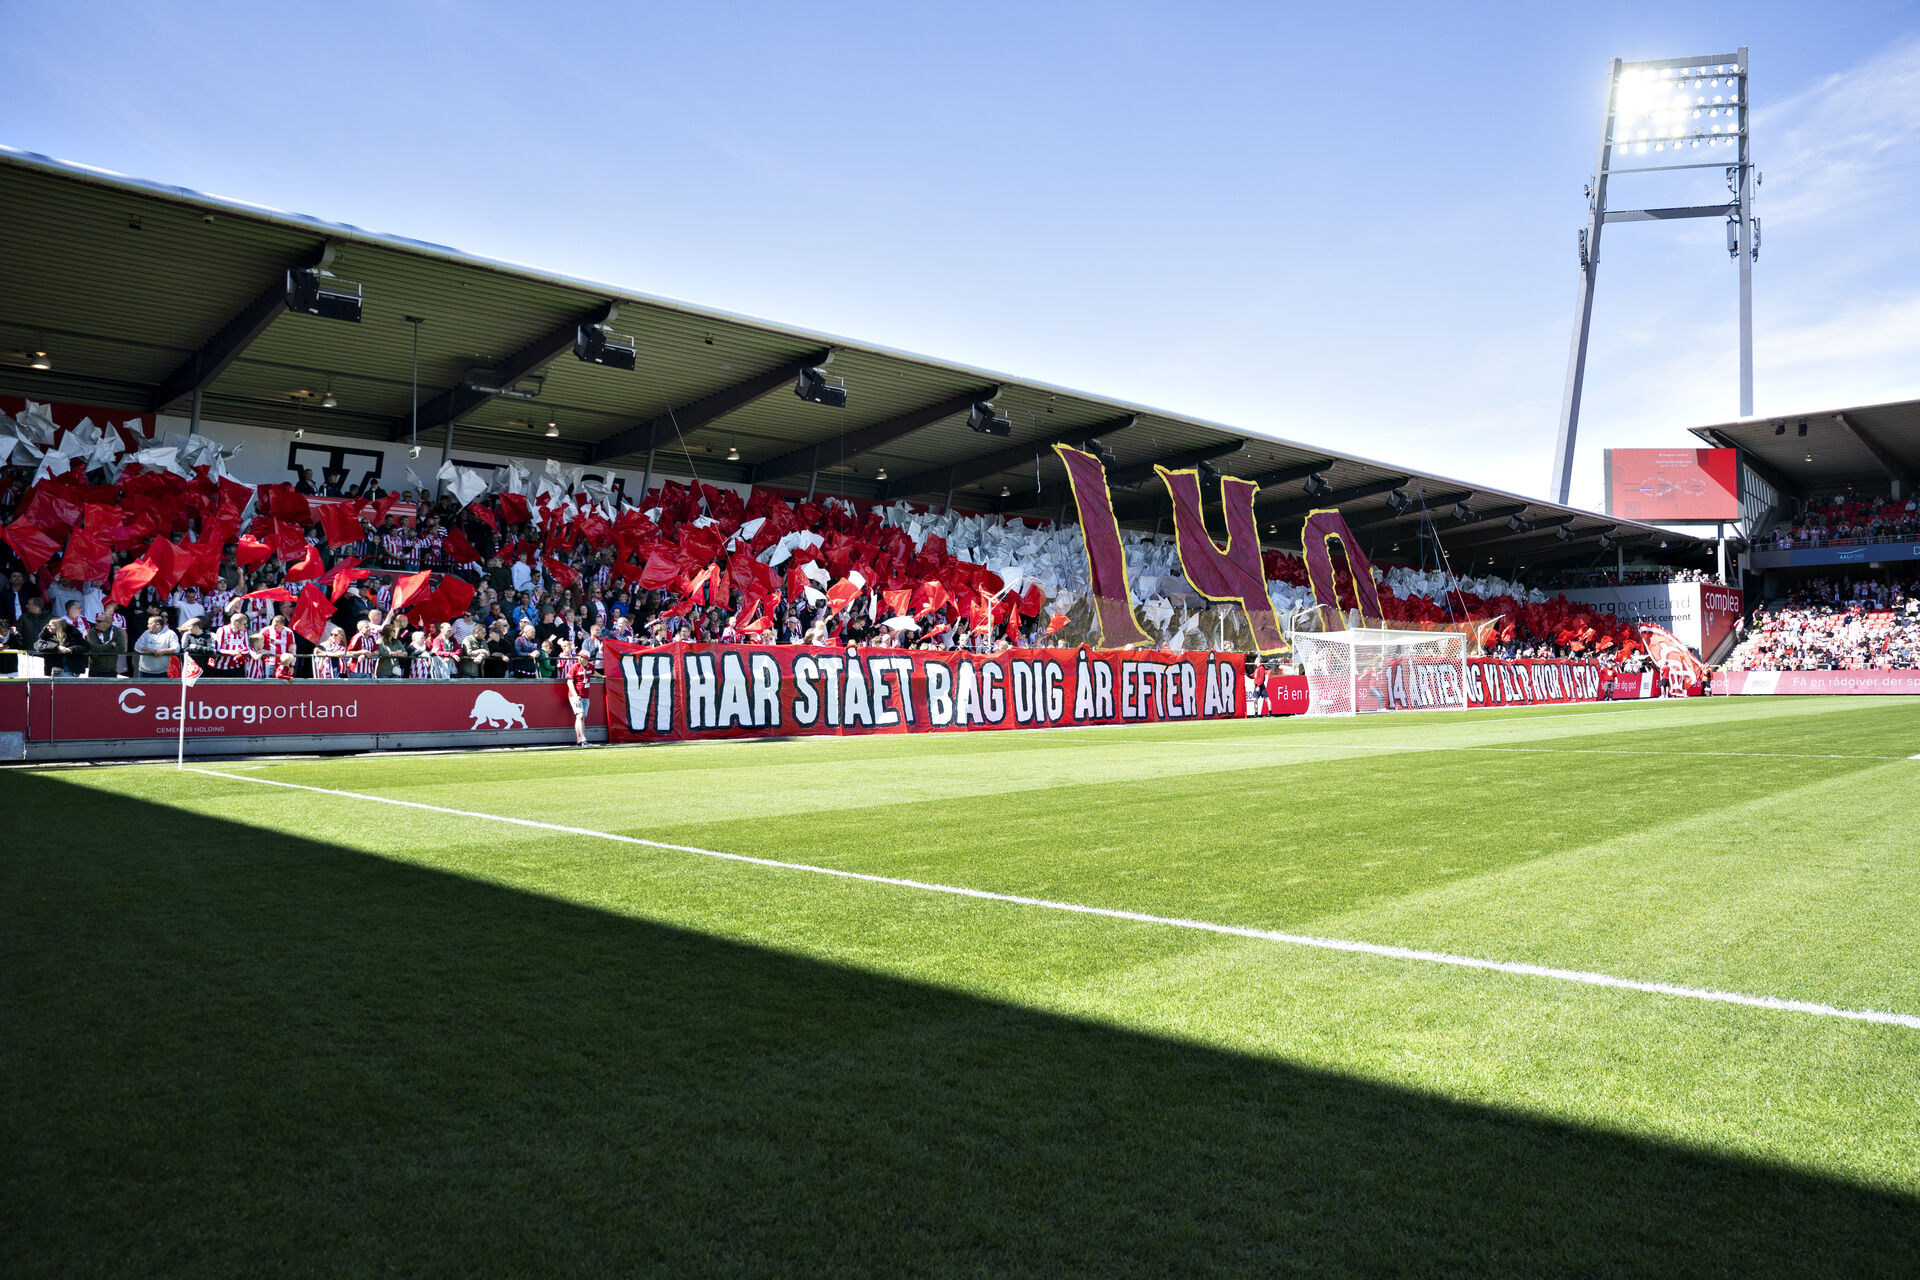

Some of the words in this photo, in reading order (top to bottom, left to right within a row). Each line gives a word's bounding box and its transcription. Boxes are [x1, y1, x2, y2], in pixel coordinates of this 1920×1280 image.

[1705, 590, 1739, 616] complea
[1658, 613, 1691, 622] cement
[620, 652, 674, 733] VI
[684, 652, 783, 731] HAR
[792, 645, 915, 730] STÅET
[924, 659, 1007, 728] BAG
[1011, 658, 1064, 724] DIG
[1073, 646, 1116, 722] ÅR
[1121, 659, 1198, 720] EFTER
[1203, 650, 1236, 716] ÅR
[1277, 686, 1289, 700] Få
[1291, 690, 1303, 700] en
[1465, 663, 1484, 703] OG
[1482, 662, 1501, 703] VI
[1531, 663, 1563, 701] HVOR
[1560, 663, 1576, 699] VI
[1793, 676, 1807, 687] Få
[1810, 679, 1825, 687] en
[1829, 676, 1878, 689] rådgiver
[1882, 677, 1903, 687] der
[154, 700, 358, 724] aalborgportland
